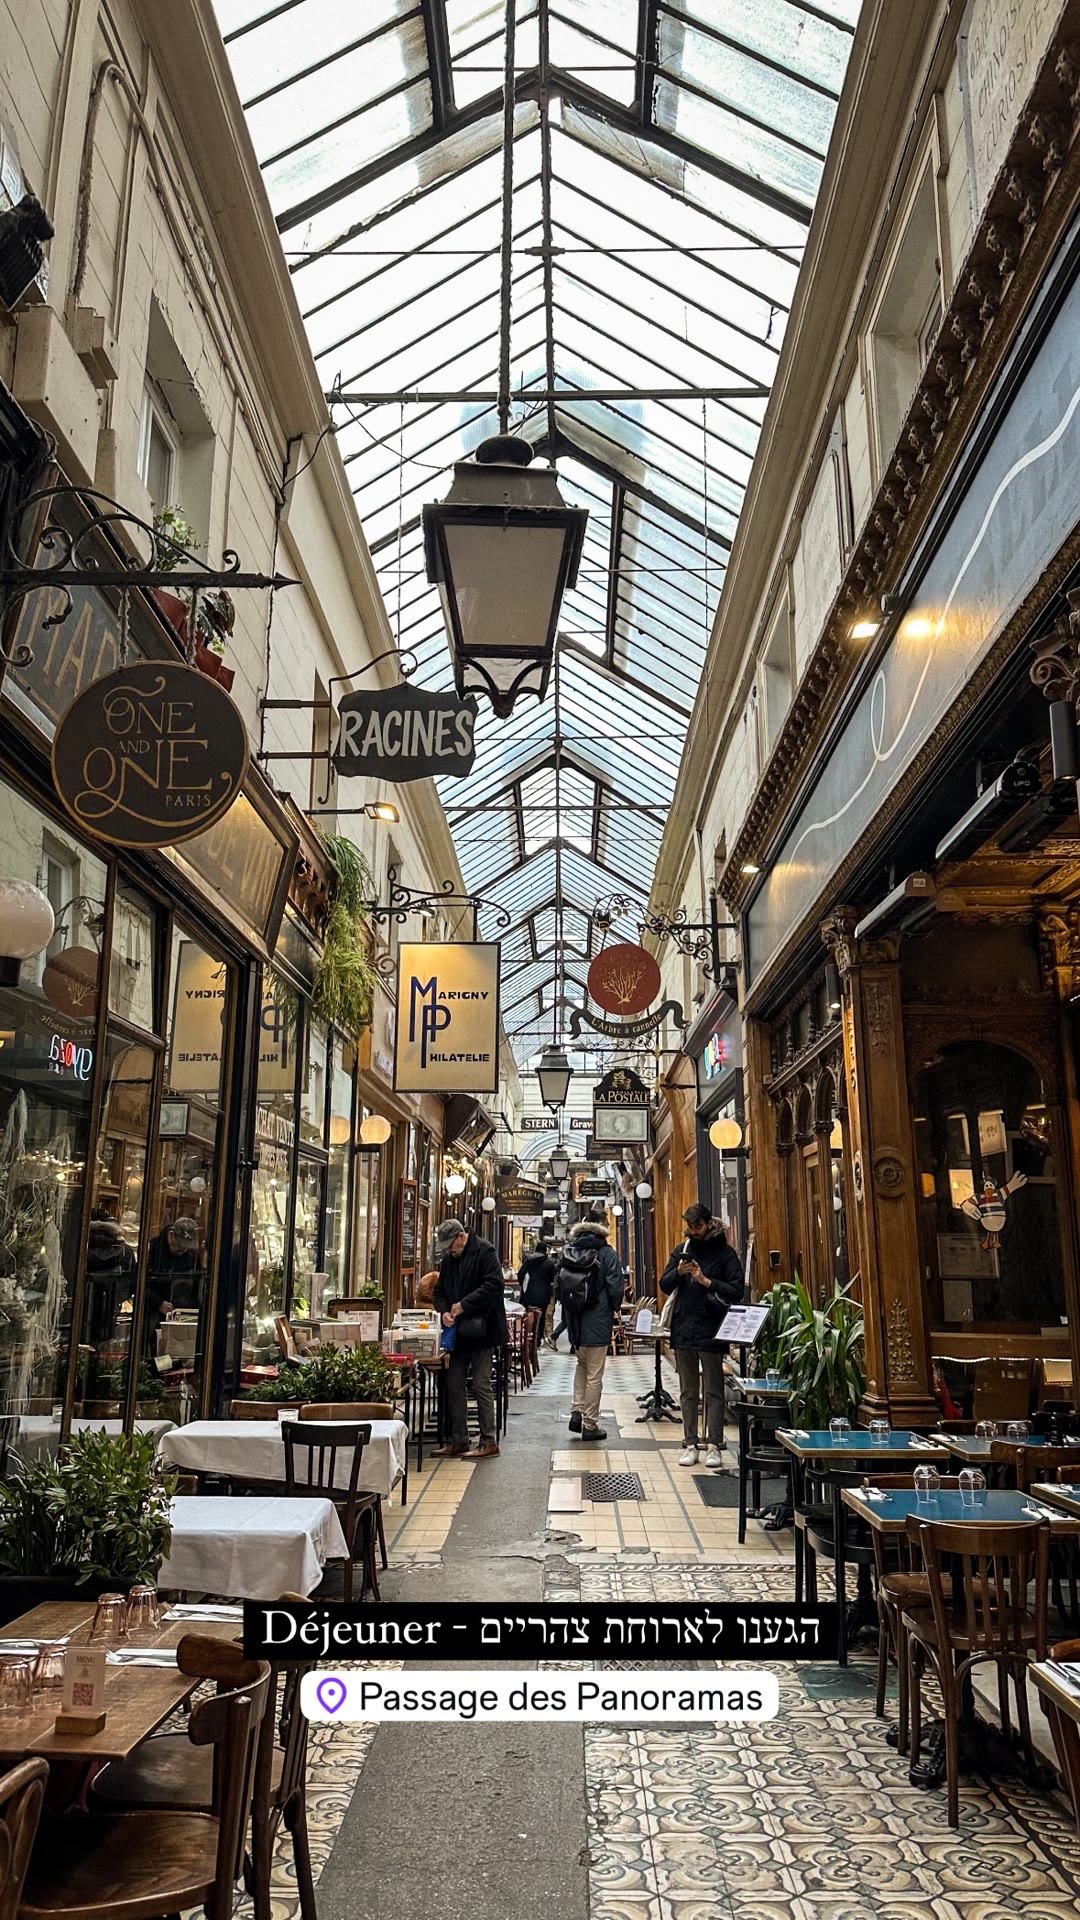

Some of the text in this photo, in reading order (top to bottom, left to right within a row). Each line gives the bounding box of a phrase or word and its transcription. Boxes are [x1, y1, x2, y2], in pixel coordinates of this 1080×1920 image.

[103, 676, 197, 736] ONE
[339, 709, 475, 758] RACINES
[115, 740, 150, 754] AND
[75, 739, 216, 818] ONE
[165, 794, 212, 808] PARIS
[591, 1017, 621, 1034] L'Arbre
[632, 1013, 662, 1033] cannelle
[593, 1090, 650, 1103] LA POSTALE
[524, 1118, 556, 1129] STERN
